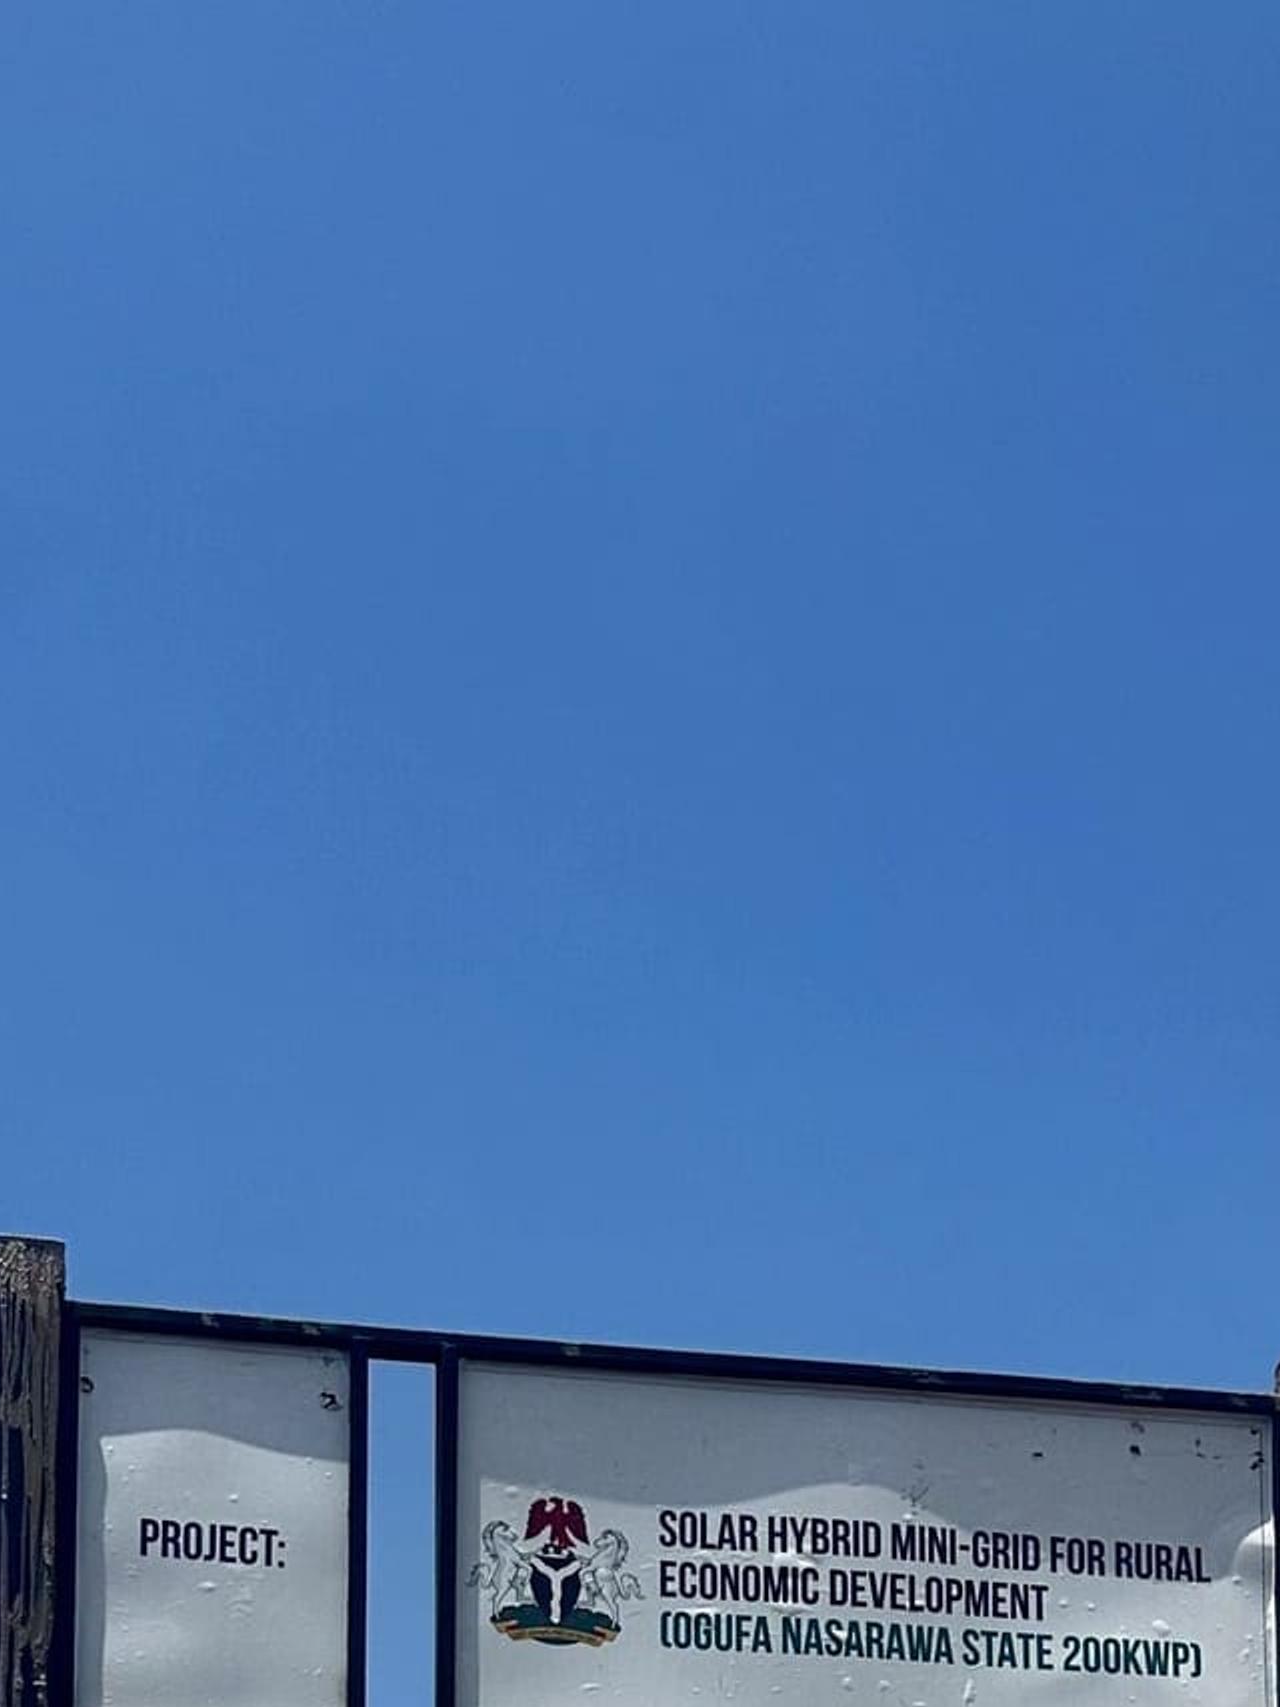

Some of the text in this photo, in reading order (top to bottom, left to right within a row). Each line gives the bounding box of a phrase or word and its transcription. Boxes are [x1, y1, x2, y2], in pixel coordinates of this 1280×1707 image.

[139, 1517, 286, 1569] PROJECT:
[658, 1509, 1211, 1583] SOLAR HYBRID MINI-GRID FOR RURAL
[660, 1560, 1049, 1621] ECONOMIC DEVELOPMENT
[660, 1611, 1202, 1678] (OGUFA NASARAWA STATE 200KWP)
